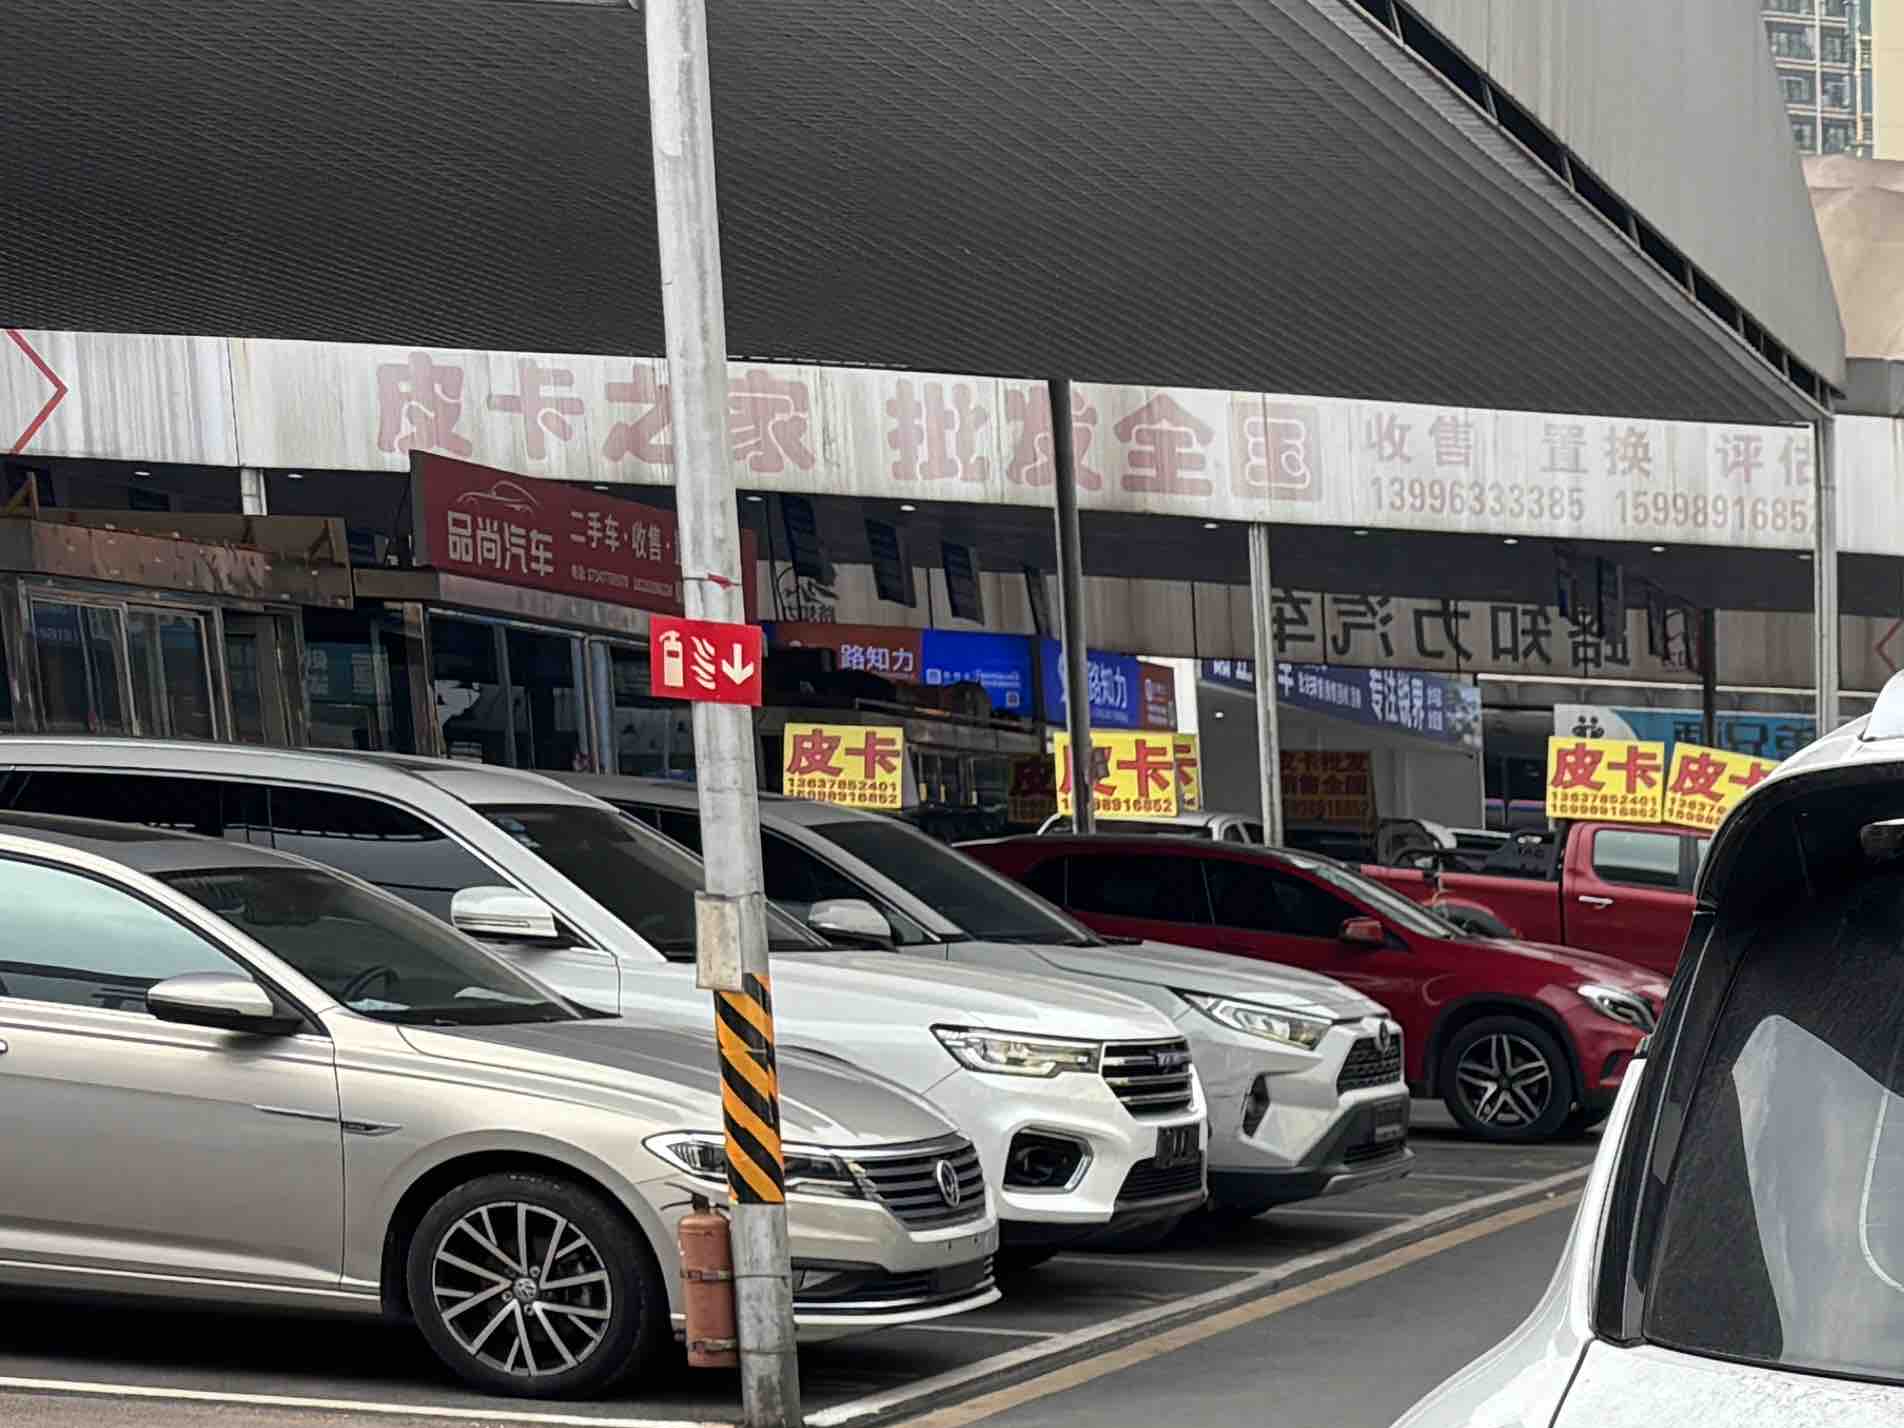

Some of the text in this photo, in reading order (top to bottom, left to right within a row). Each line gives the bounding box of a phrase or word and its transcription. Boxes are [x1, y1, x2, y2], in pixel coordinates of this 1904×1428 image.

[376, 351, 820, 474] 皮卡之家
[885, 377, 1323, 502] 批发全国
[1364, 411, 1475, 468] 收售
[1540, 422, 1653, 479] 置换
[1369, 476, 1815, 535] 13996333385 1599891685
[447, 509, 555, 578] 品尚汽车
[840, 644, 914, 672] 路知力
[786, 728, 901, 779] 皮卡
[1551, 742, 1662, 794] 皮卡
